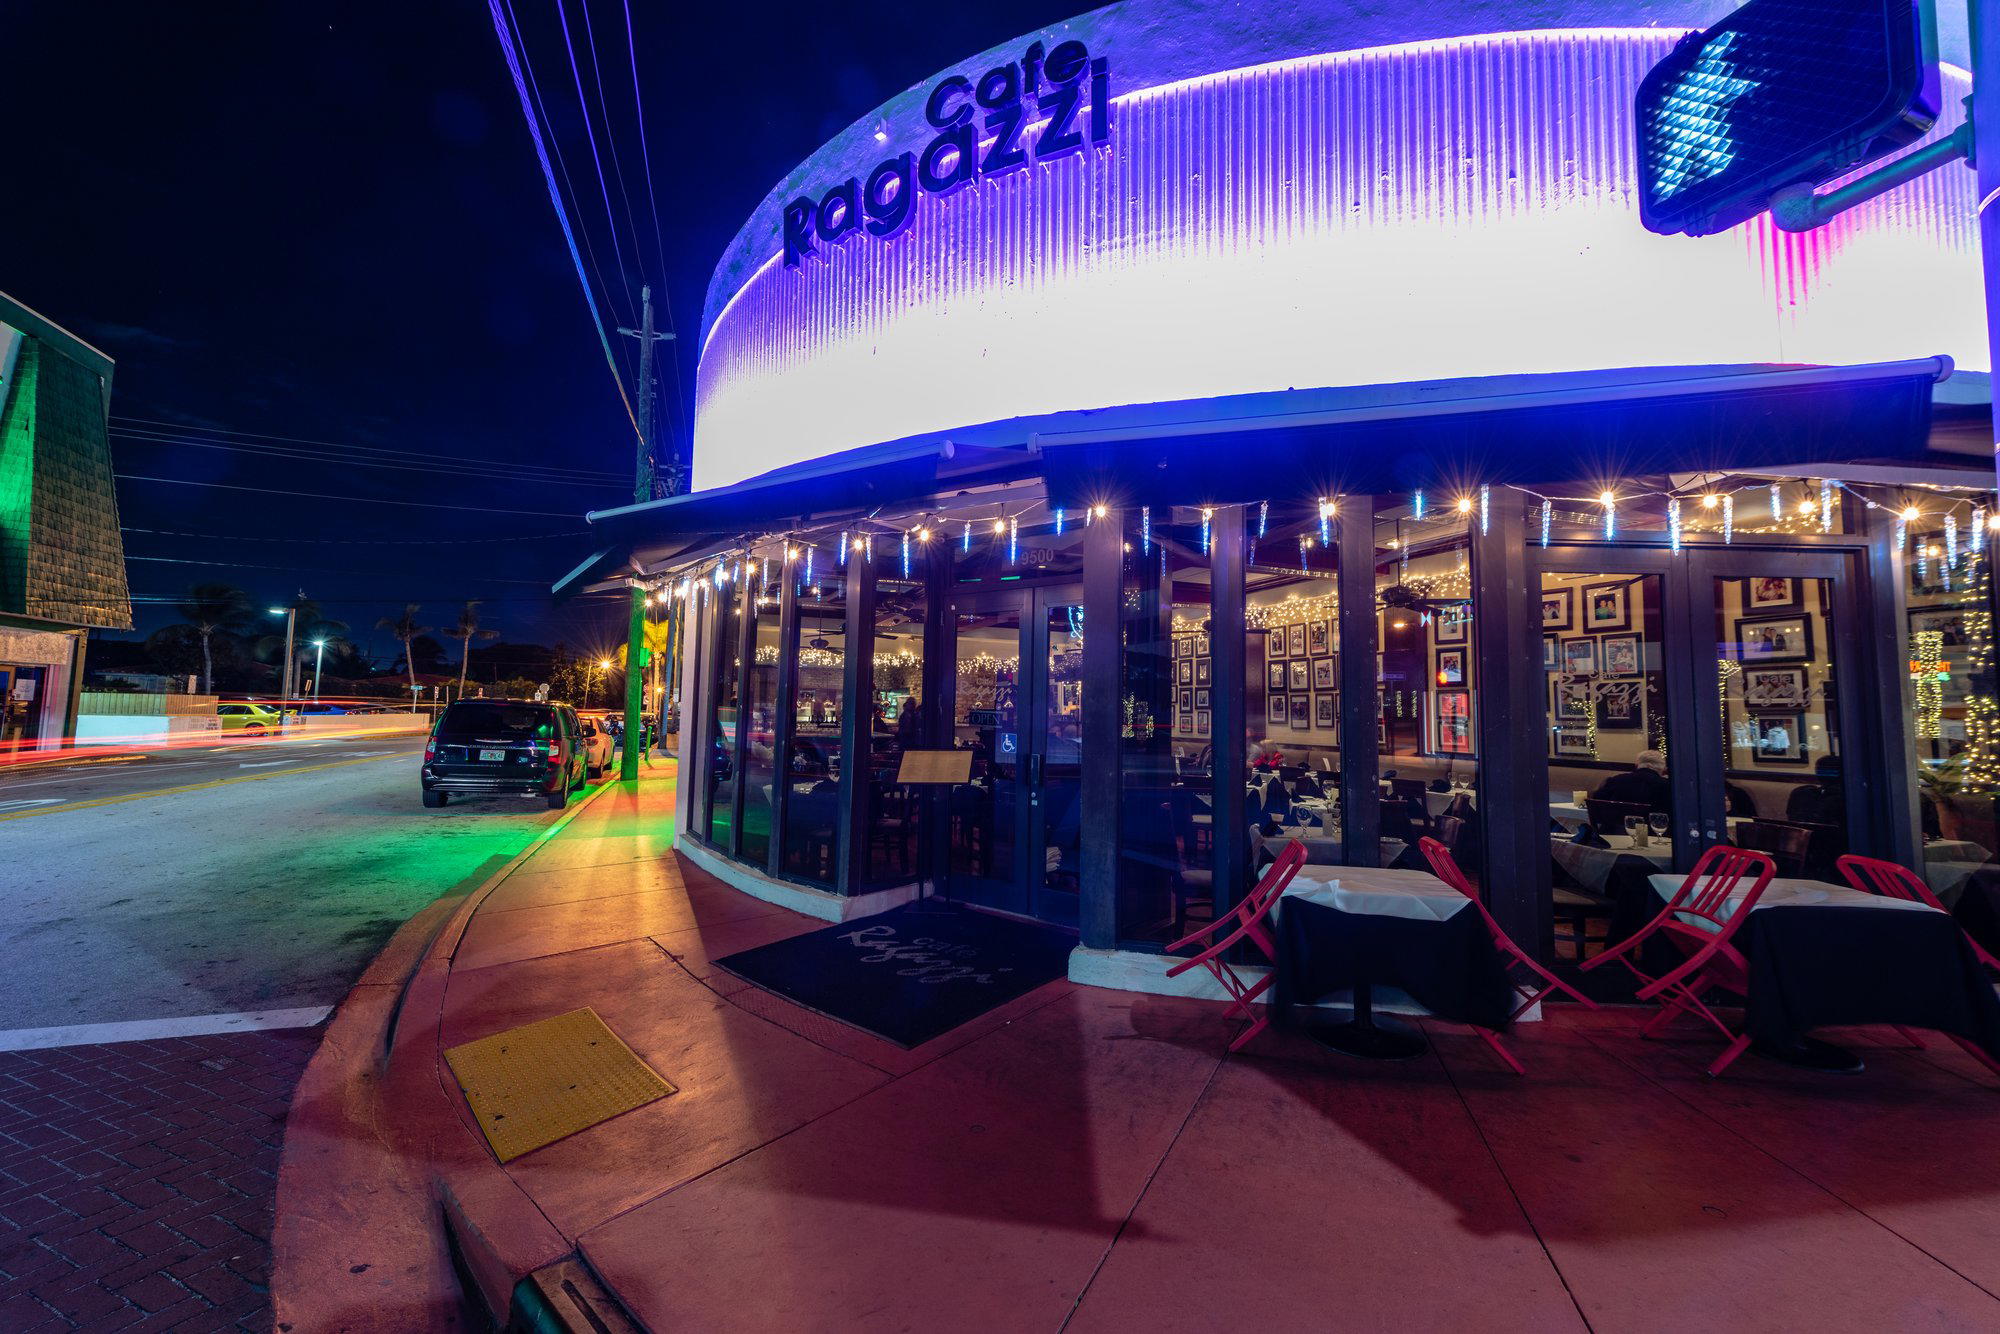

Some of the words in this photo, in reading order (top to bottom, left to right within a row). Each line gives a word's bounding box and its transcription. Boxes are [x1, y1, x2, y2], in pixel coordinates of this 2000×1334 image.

[925, 40, 1091, 128] Cafe
[783, 57, 1112, 269] Ragazzi
[1021, 549, 1054, 565] 9500
[958, 680, 1013, 702] Ragazzi
[1558, 674, 1658, 704] Ragazzi
[971, 713, 1000, 725] OPEN
